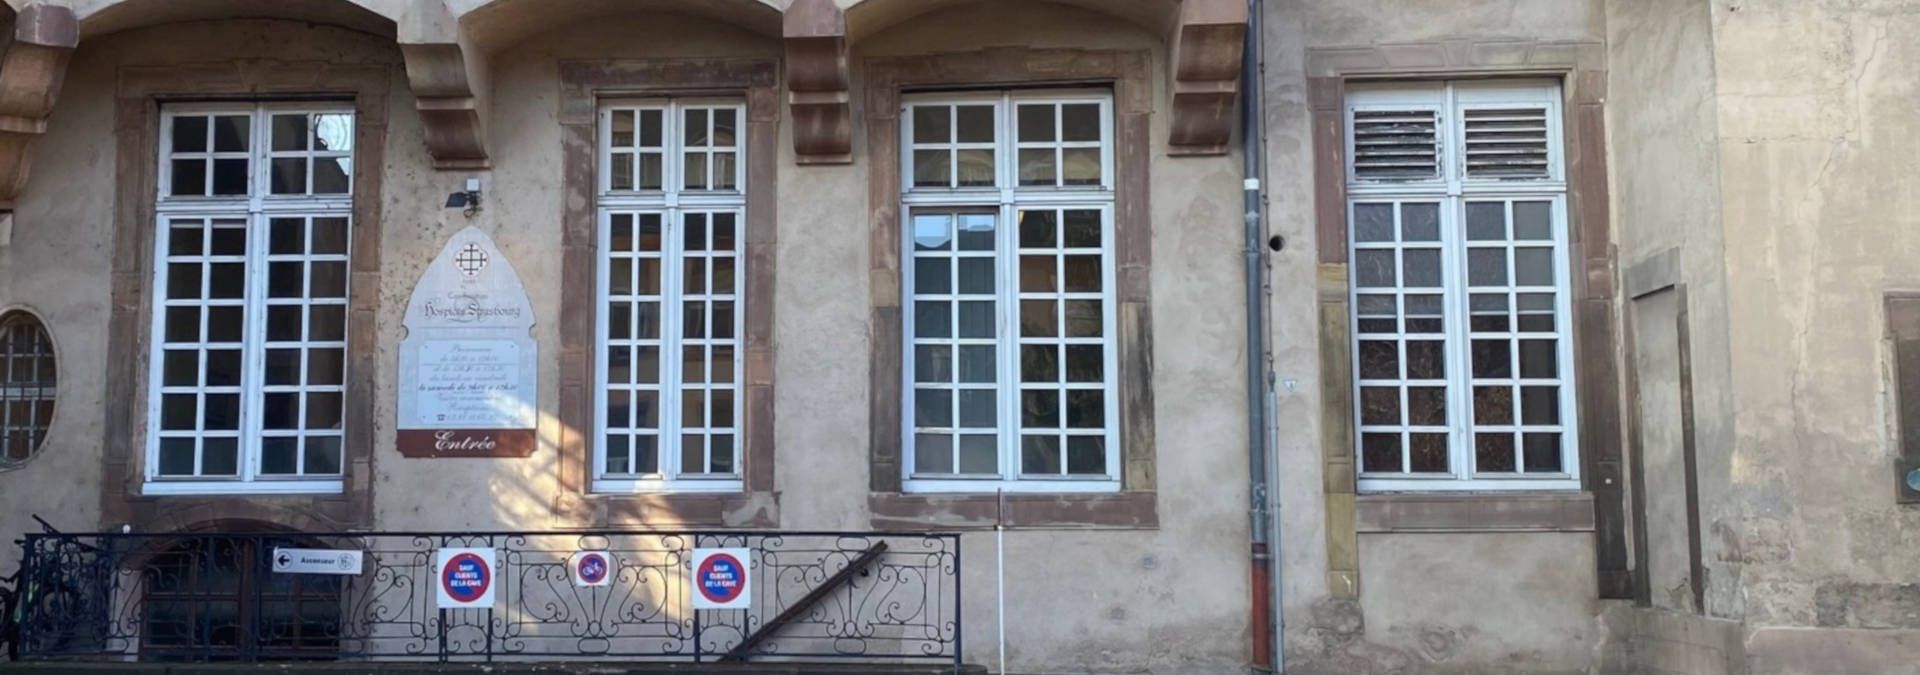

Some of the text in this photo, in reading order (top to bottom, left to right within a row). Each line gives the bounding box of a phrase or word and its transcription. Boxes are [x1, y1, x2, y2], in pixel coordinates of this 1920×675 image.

[467, 302, 521, 322] Strasbourg
[434, 430, 497, 451] Entrée
[453, 571, 478, 579] CLIENTS
[709, 572, 733, 580] CLIENTS
[450, 579, 458, 587] DE
[459, 579, 466, 587] LA
